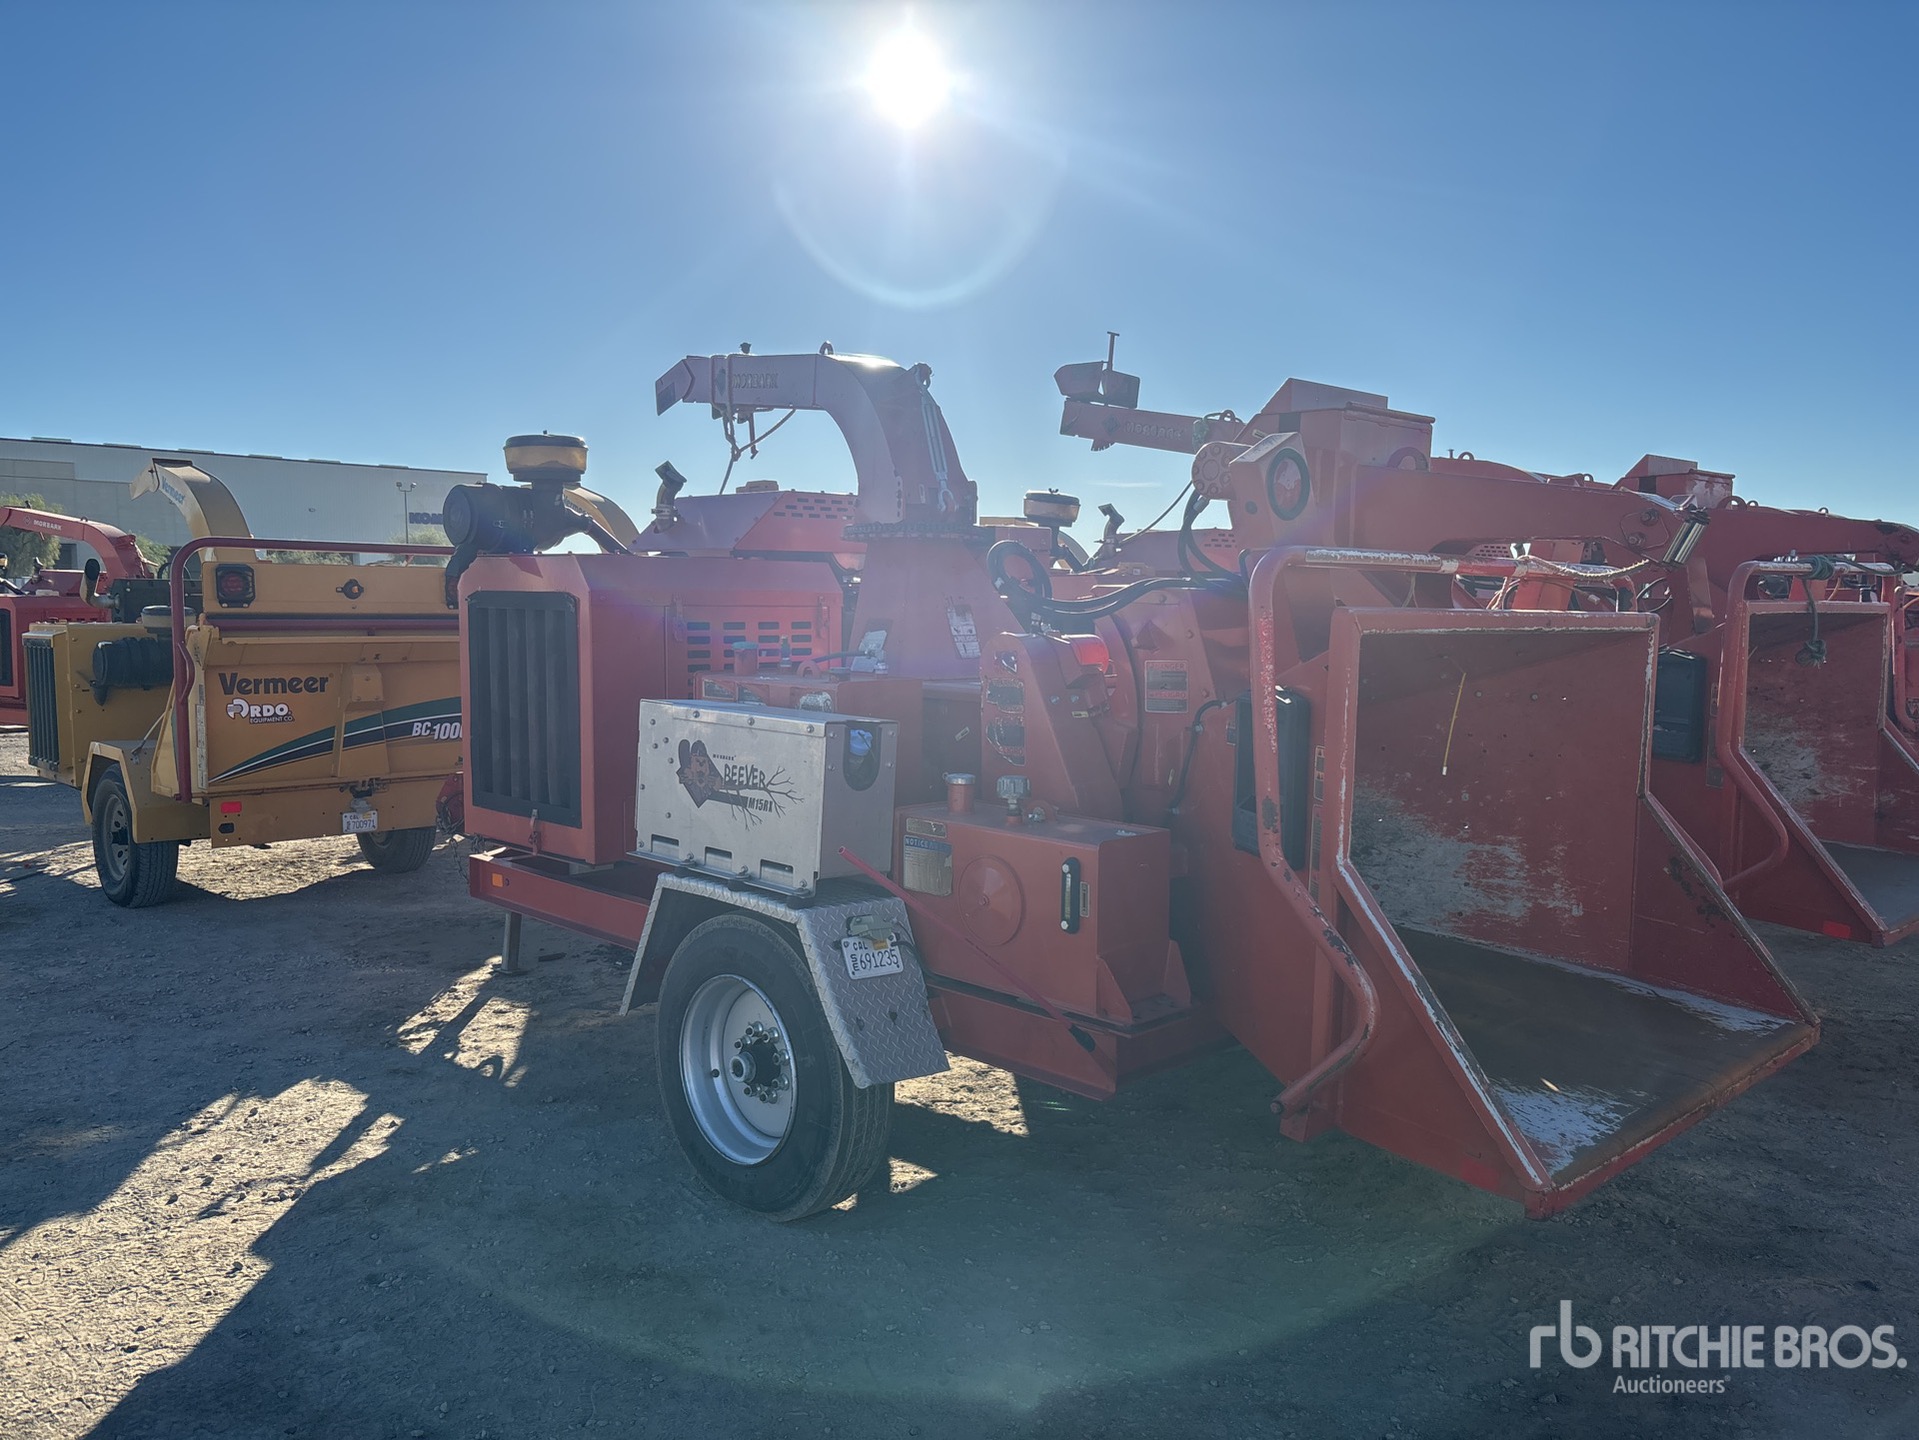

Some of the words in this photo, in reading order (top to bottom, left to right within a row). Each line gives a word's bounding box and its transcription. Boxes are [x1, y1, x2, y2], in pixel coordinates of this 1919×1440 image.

[218, 672, 329, 695] Vermeer
[724, 763, 766, 789] BEEVER
[905, 838, 929, 849] NOTICE
[852, 941, 868, 951] CAL
[860, 948, 899, 970] 691235
